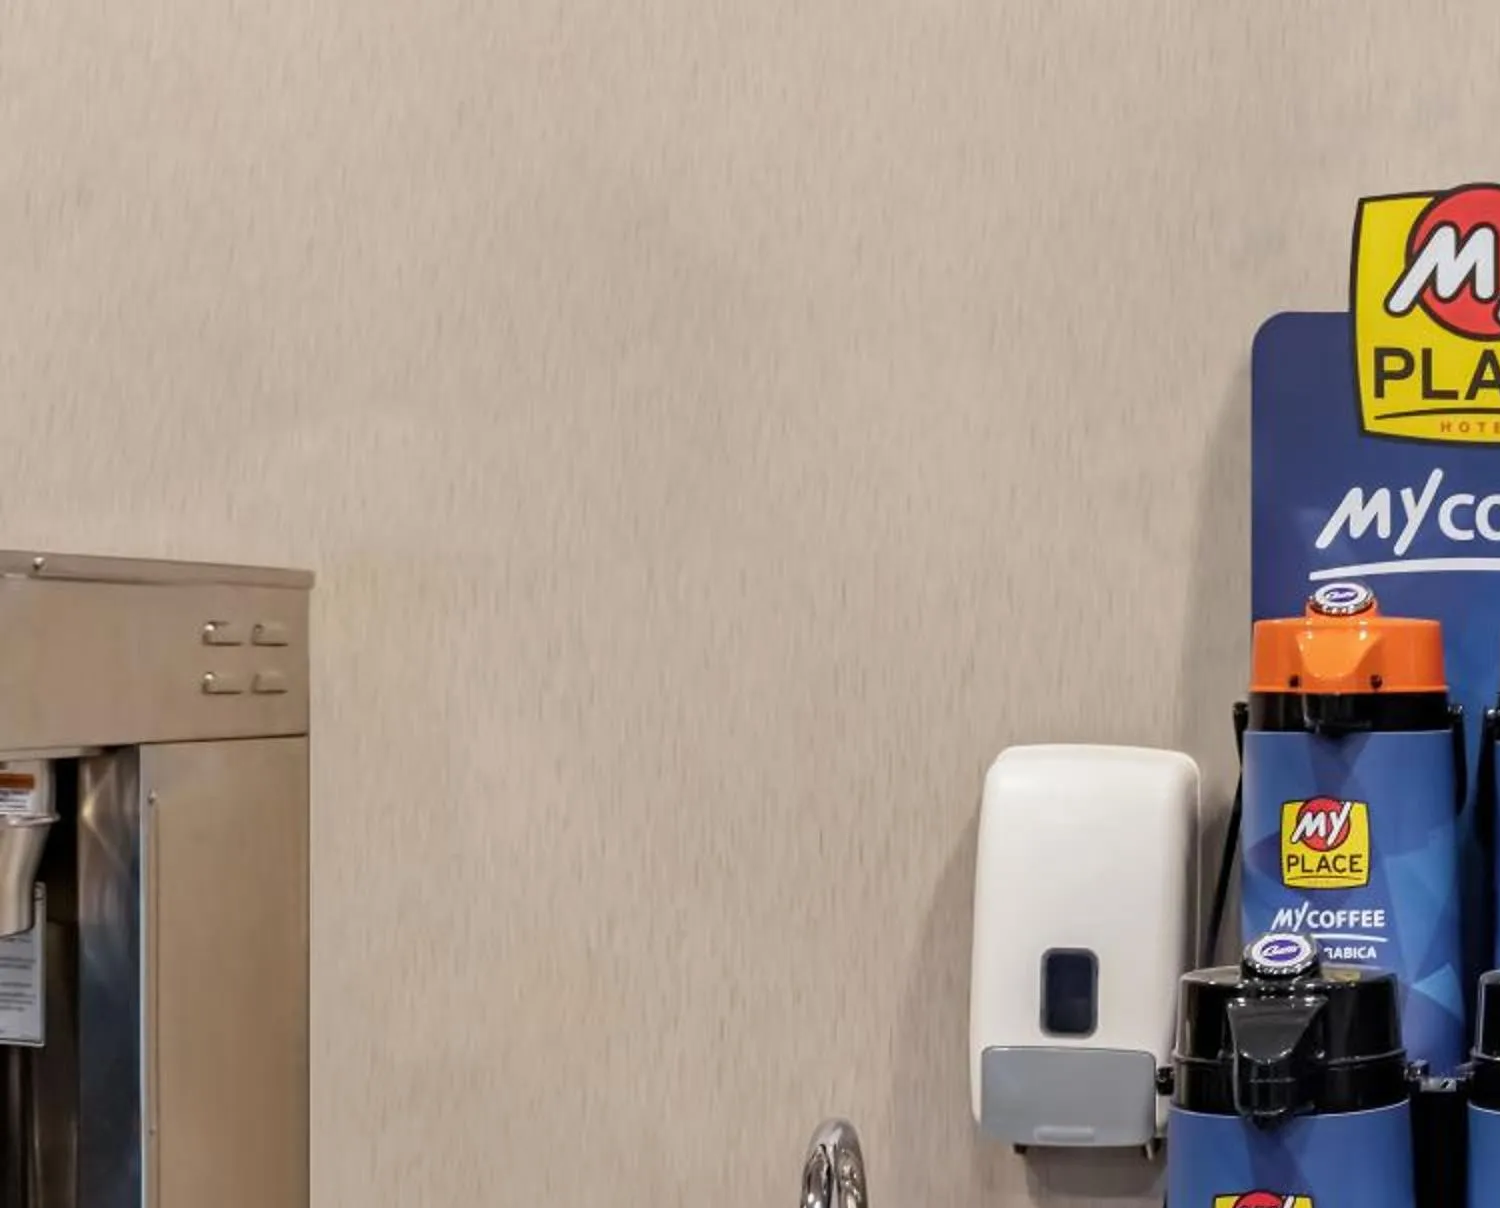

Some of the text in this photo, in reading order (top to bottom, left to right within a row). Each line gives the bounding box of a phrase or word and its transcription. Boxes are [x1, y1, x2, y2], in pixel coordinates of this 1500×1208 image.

[1291, 801, 1352, 846] MY
[1286, 854, 1363, 873] PLACE
[1323, 946, 1378, 960] RABICA
